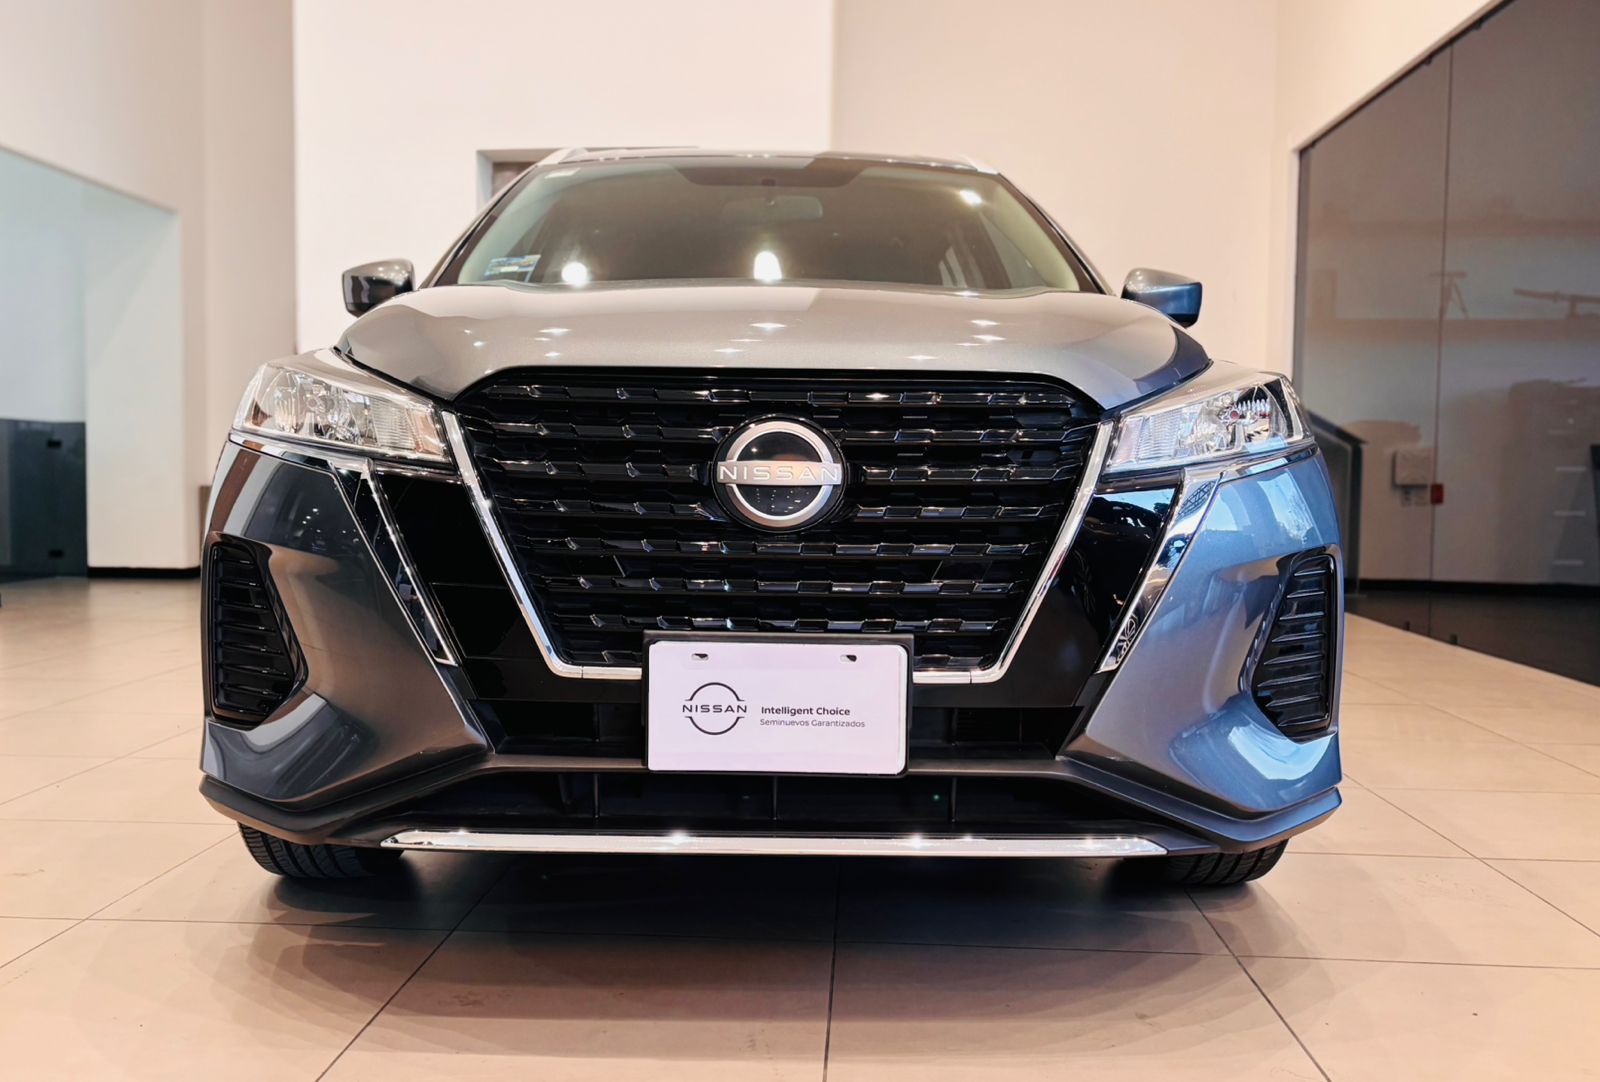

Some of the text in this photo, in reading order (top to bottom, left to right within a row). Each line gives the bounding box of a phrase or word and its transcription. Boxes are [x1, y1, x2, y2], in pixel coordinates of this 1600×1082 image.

[719, 465, 838, 481] NISSAN
[682, 704, 747, 713] NISSAN
[761, 706, 851, 717] Intelligent Choice
[760, 718, 866, 728] Seminuevos Garantizados
